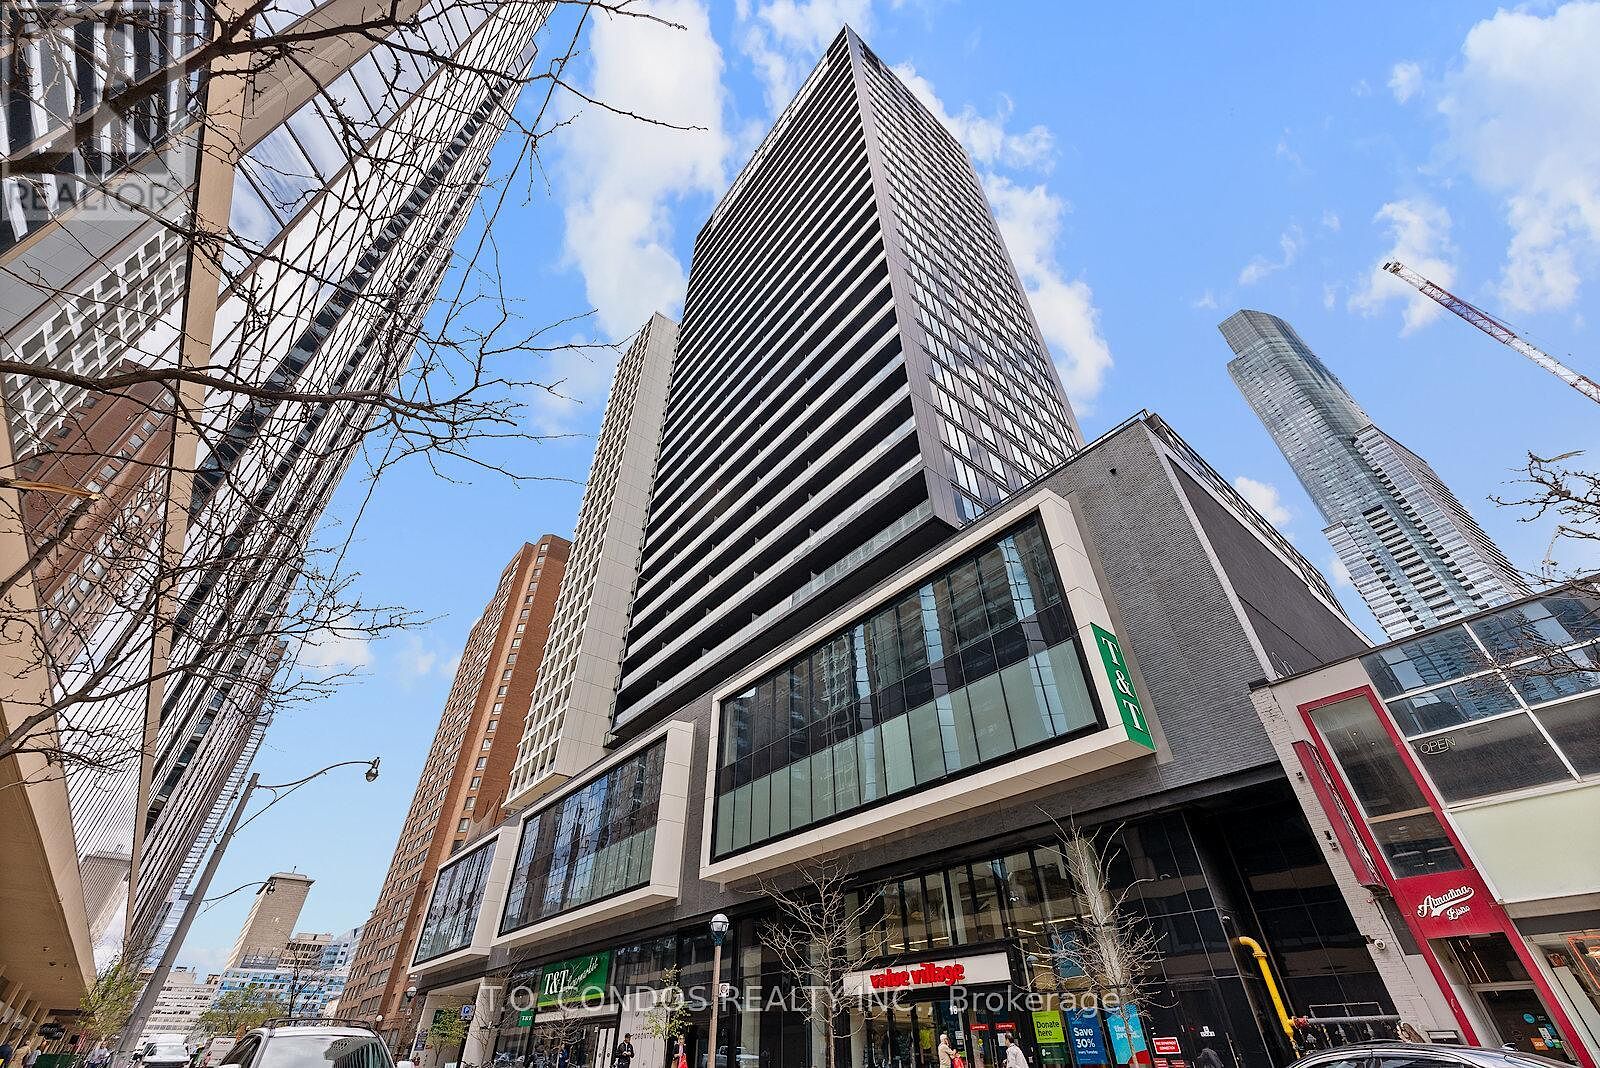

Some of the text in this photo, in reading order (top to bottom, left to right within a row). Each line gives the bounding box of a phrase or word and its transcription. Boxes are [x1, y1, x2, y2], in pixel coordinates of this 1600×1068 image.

[1101, 637, 1142, 732] T&T
[1420, 737, 1456, 753] OPEN
[870, 962, 965, 988] value village
[543, 969, 569, 995] T&T
[1036, 1021, 1060, 1029] Donate
[1038, 1029, 1053, 1037] here
[1073, 1027, 1094, 1037] Save
[1075, 1038, 1096, 1048] 30%
